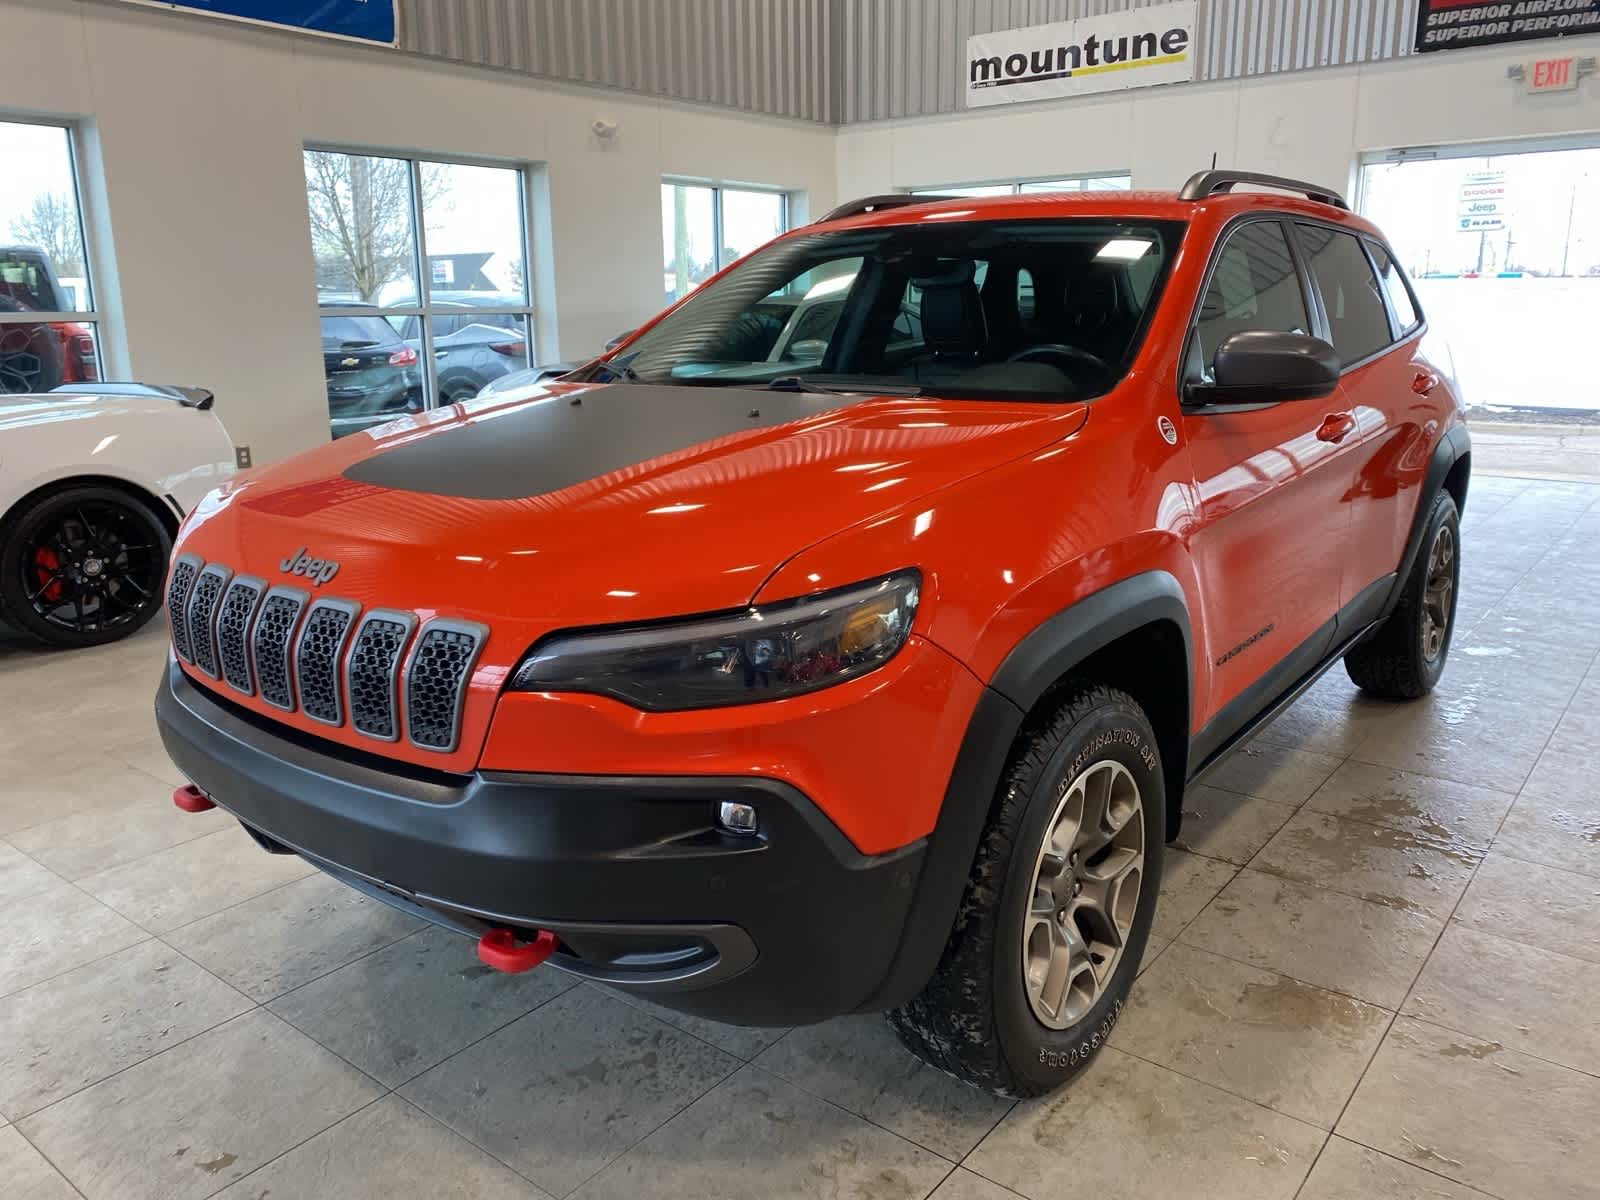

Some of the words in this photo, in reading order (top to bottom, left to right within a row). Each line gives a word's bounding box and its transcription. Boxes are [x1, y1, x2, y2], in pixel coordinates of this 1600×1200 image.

[1427, 5, 1510, 26] SUPERIOR
[1424, 21, 1509, 43] SUPERIOR
[970, 28, 1189, 82] mountune
[1534, 58, 1572, 88] EXIT
[1468, 202, 1496, 212] Jeep
[279, 546, 340, 587] Jeep
